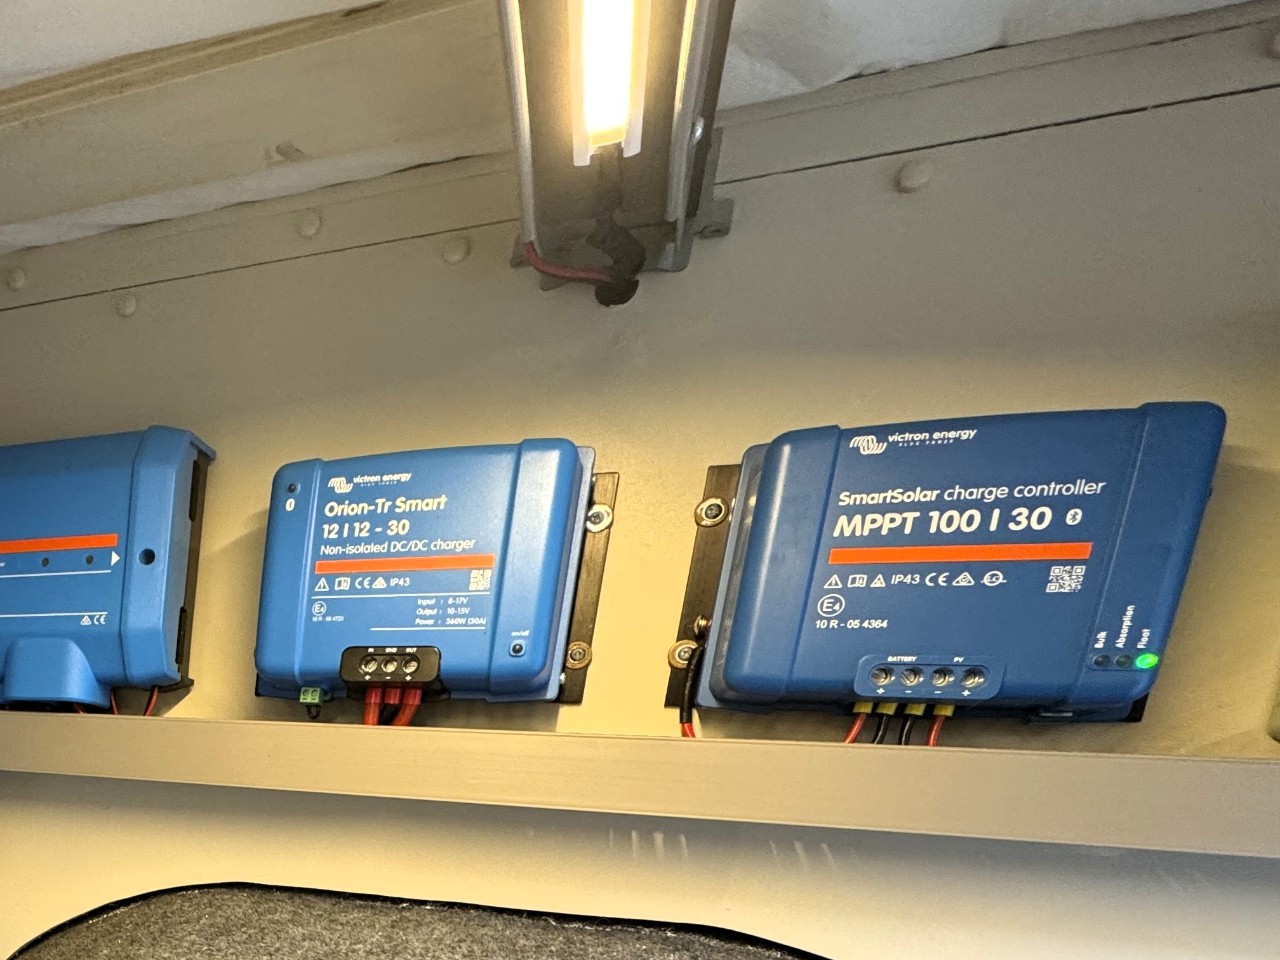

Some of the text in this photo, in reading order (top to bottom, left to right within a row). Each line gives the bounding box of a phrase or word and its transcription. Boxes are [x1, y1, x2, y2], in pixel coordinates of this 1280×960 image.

[888, 429, 977, 442] victron energy
[353, 475, 381, 484] victron
[382, 472, 412, 482] energy
[838, 479, 1106, 506] SmartSolar charge controller
[324, 494, 448, 517] Orion-Tr Smart
[322, 523, 339, 539] 12
[353, 521, 370, 537] 12
[387, 519, 410, 536] 30
[833, 511, 920, 537] MPPT
[928, 509, 981, 534] 100
[1008, 506, 1052, 531] 30
[320, 538, 477, 556] Non-isolated DC/DC charger
[389, 578, 411, 587] IP43
[891, 573, 920, 585] IP43
[417, 598, 436, 607] Input
[447, 607, 470, 615] 10-15V
[815, 619, 828, 628] 10
[829, 619, 838, 628] R
[847, 619, 860, 628] 05
[862, 619, 888, 628] 4364
[1115, 605, 1135, 648] Absorption
[1093, 631, 1108, 648] Bulk
[1137, 628, 1151, 648] Float
